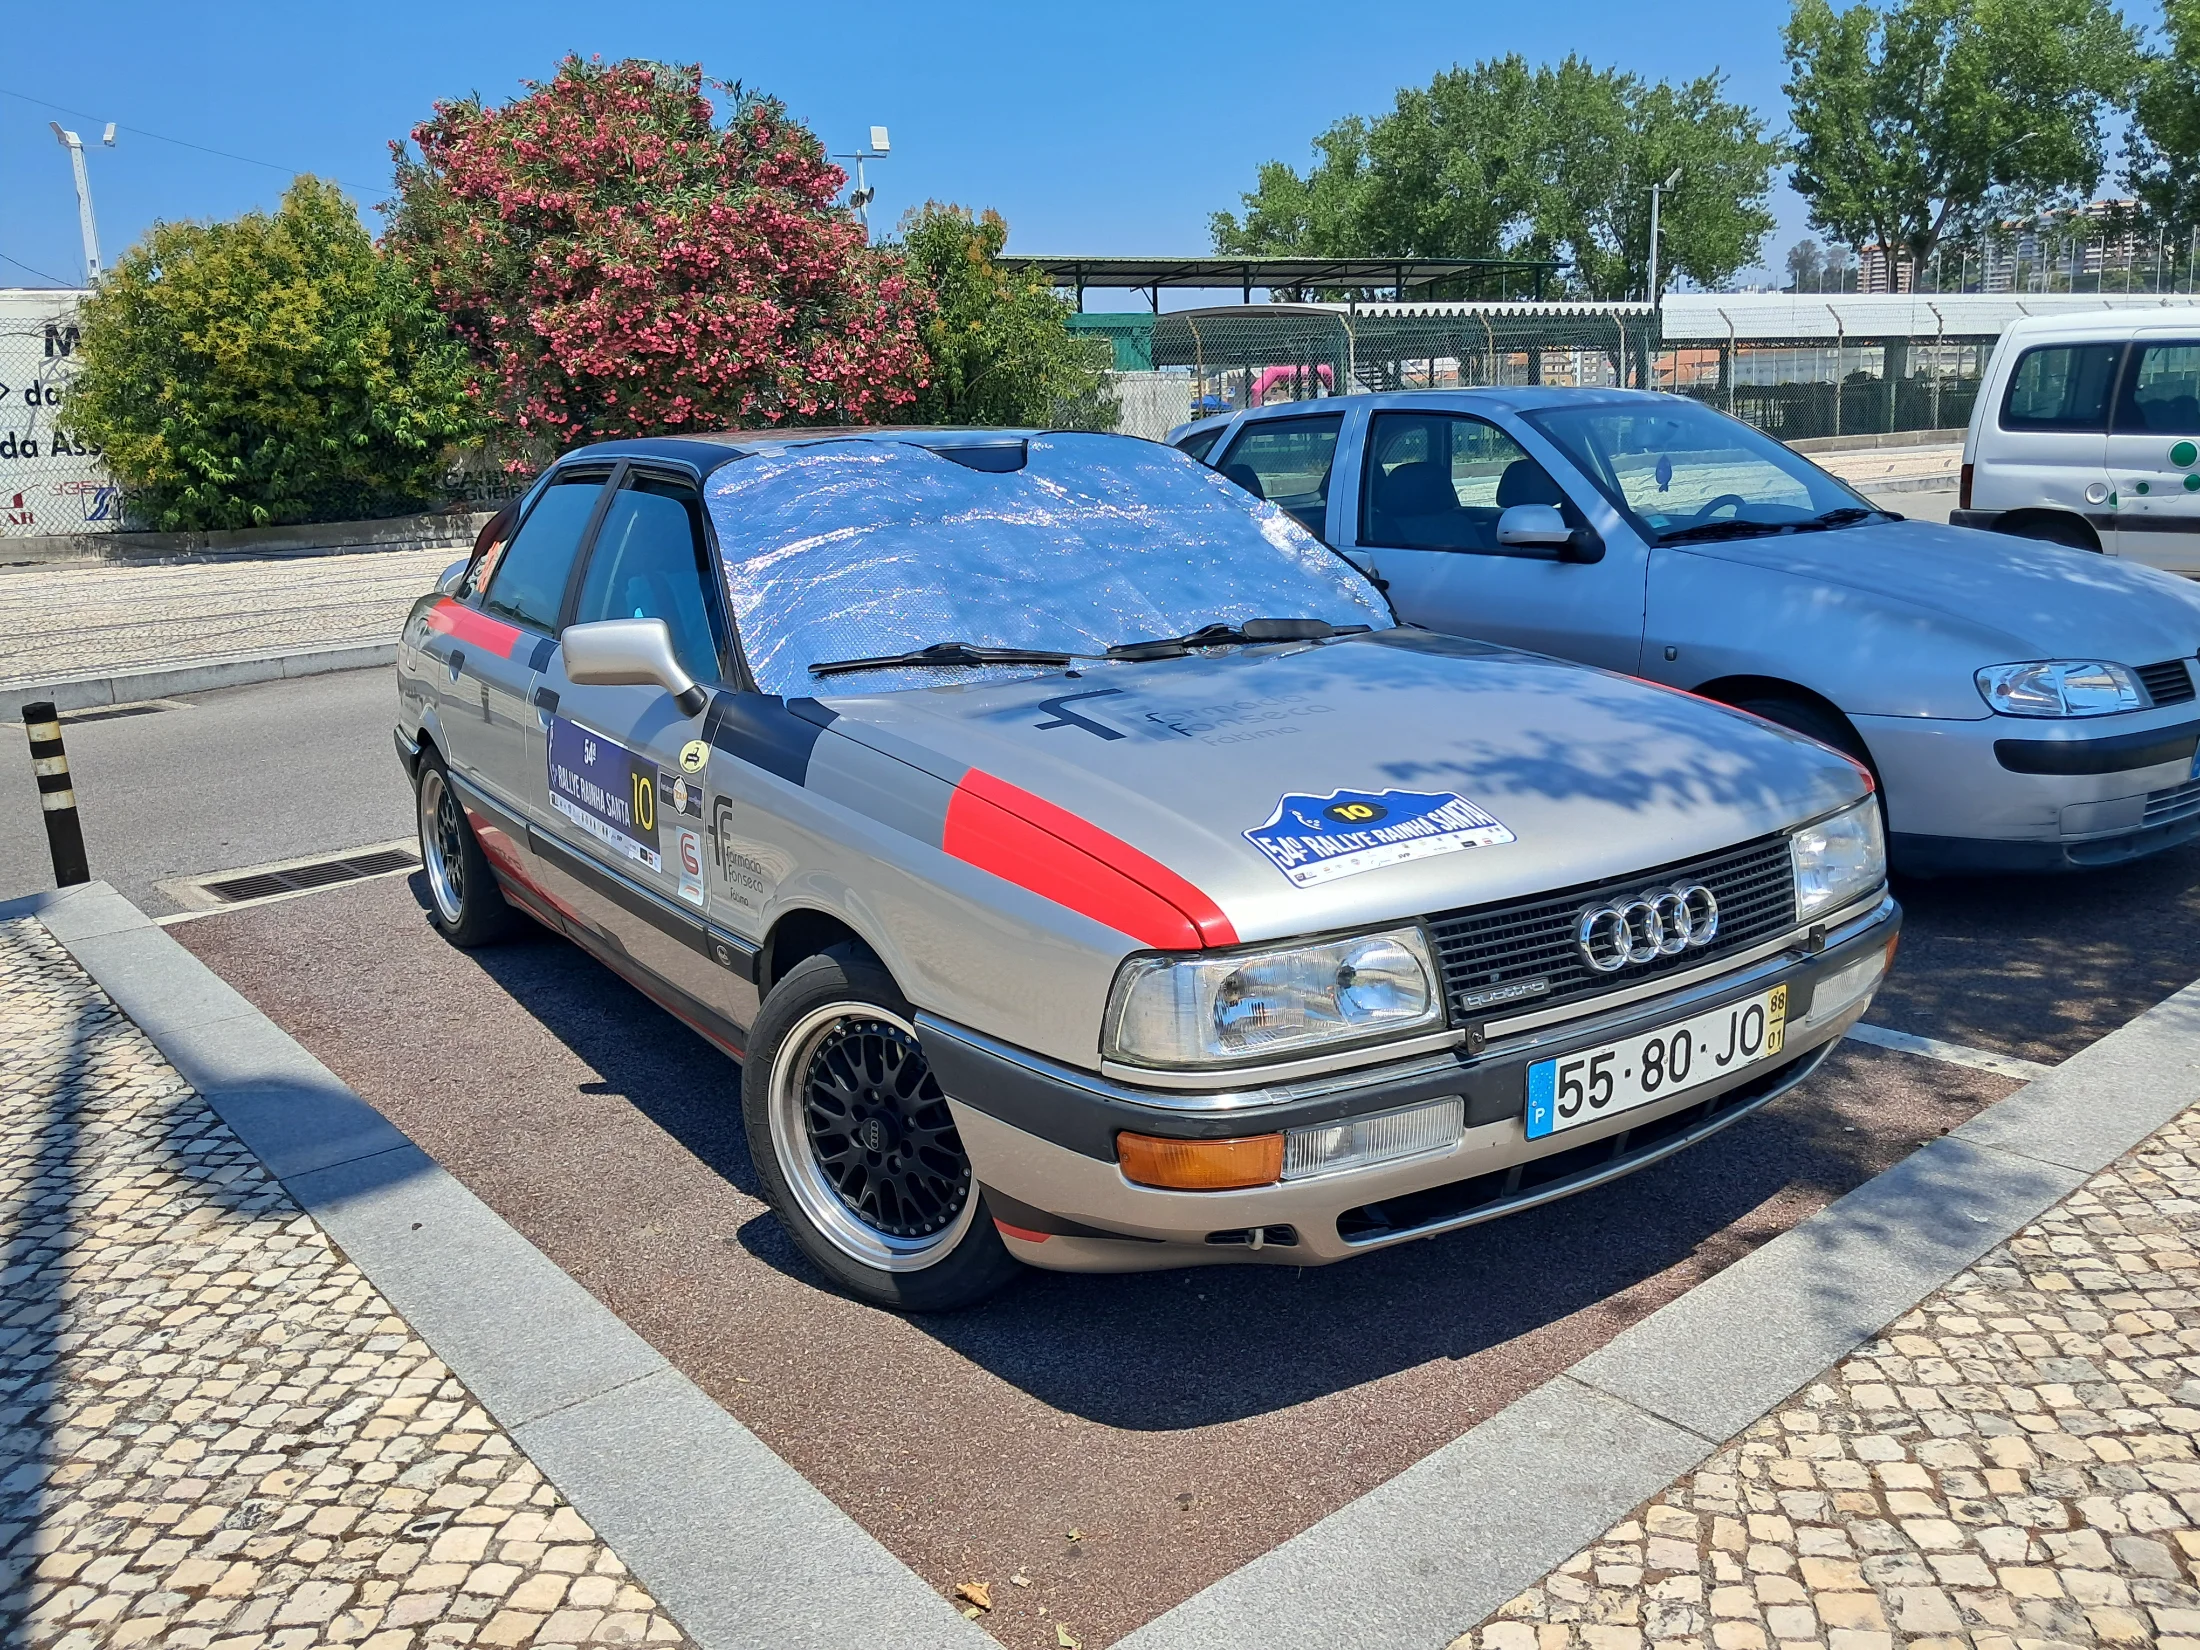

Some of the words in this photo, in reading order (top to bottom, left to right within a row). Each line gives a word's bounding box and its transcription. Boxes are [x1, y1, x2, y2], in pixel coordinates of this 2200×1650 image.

[0, 431, 38, 459] da
[1167, 704, 1336, 737] Fonseca
[1200, 725, 1303, 747] Fátima
[557, 764, 581, 799] RALLYE
[580, 775, 606, 813] RAINHA
[606, 790, 632, 828] SANTA
[631, 772, 655, 831] 10
[1333, 804, 1374, 822] 10
[1301, 831, 1379, 859] RALLYE
[1371, 817, 1441, 844] RAINHA
[1427, 798, 1495, 832] SANTA
[728, 866, 764, 894] Fonseca
[1467, 981, 1545, 1006] quattro
[1769, 991, 1786, 1013] 88
[1767, 1032, 1781, 1051] 01
[1533, 1108, 1545, 1124] P
